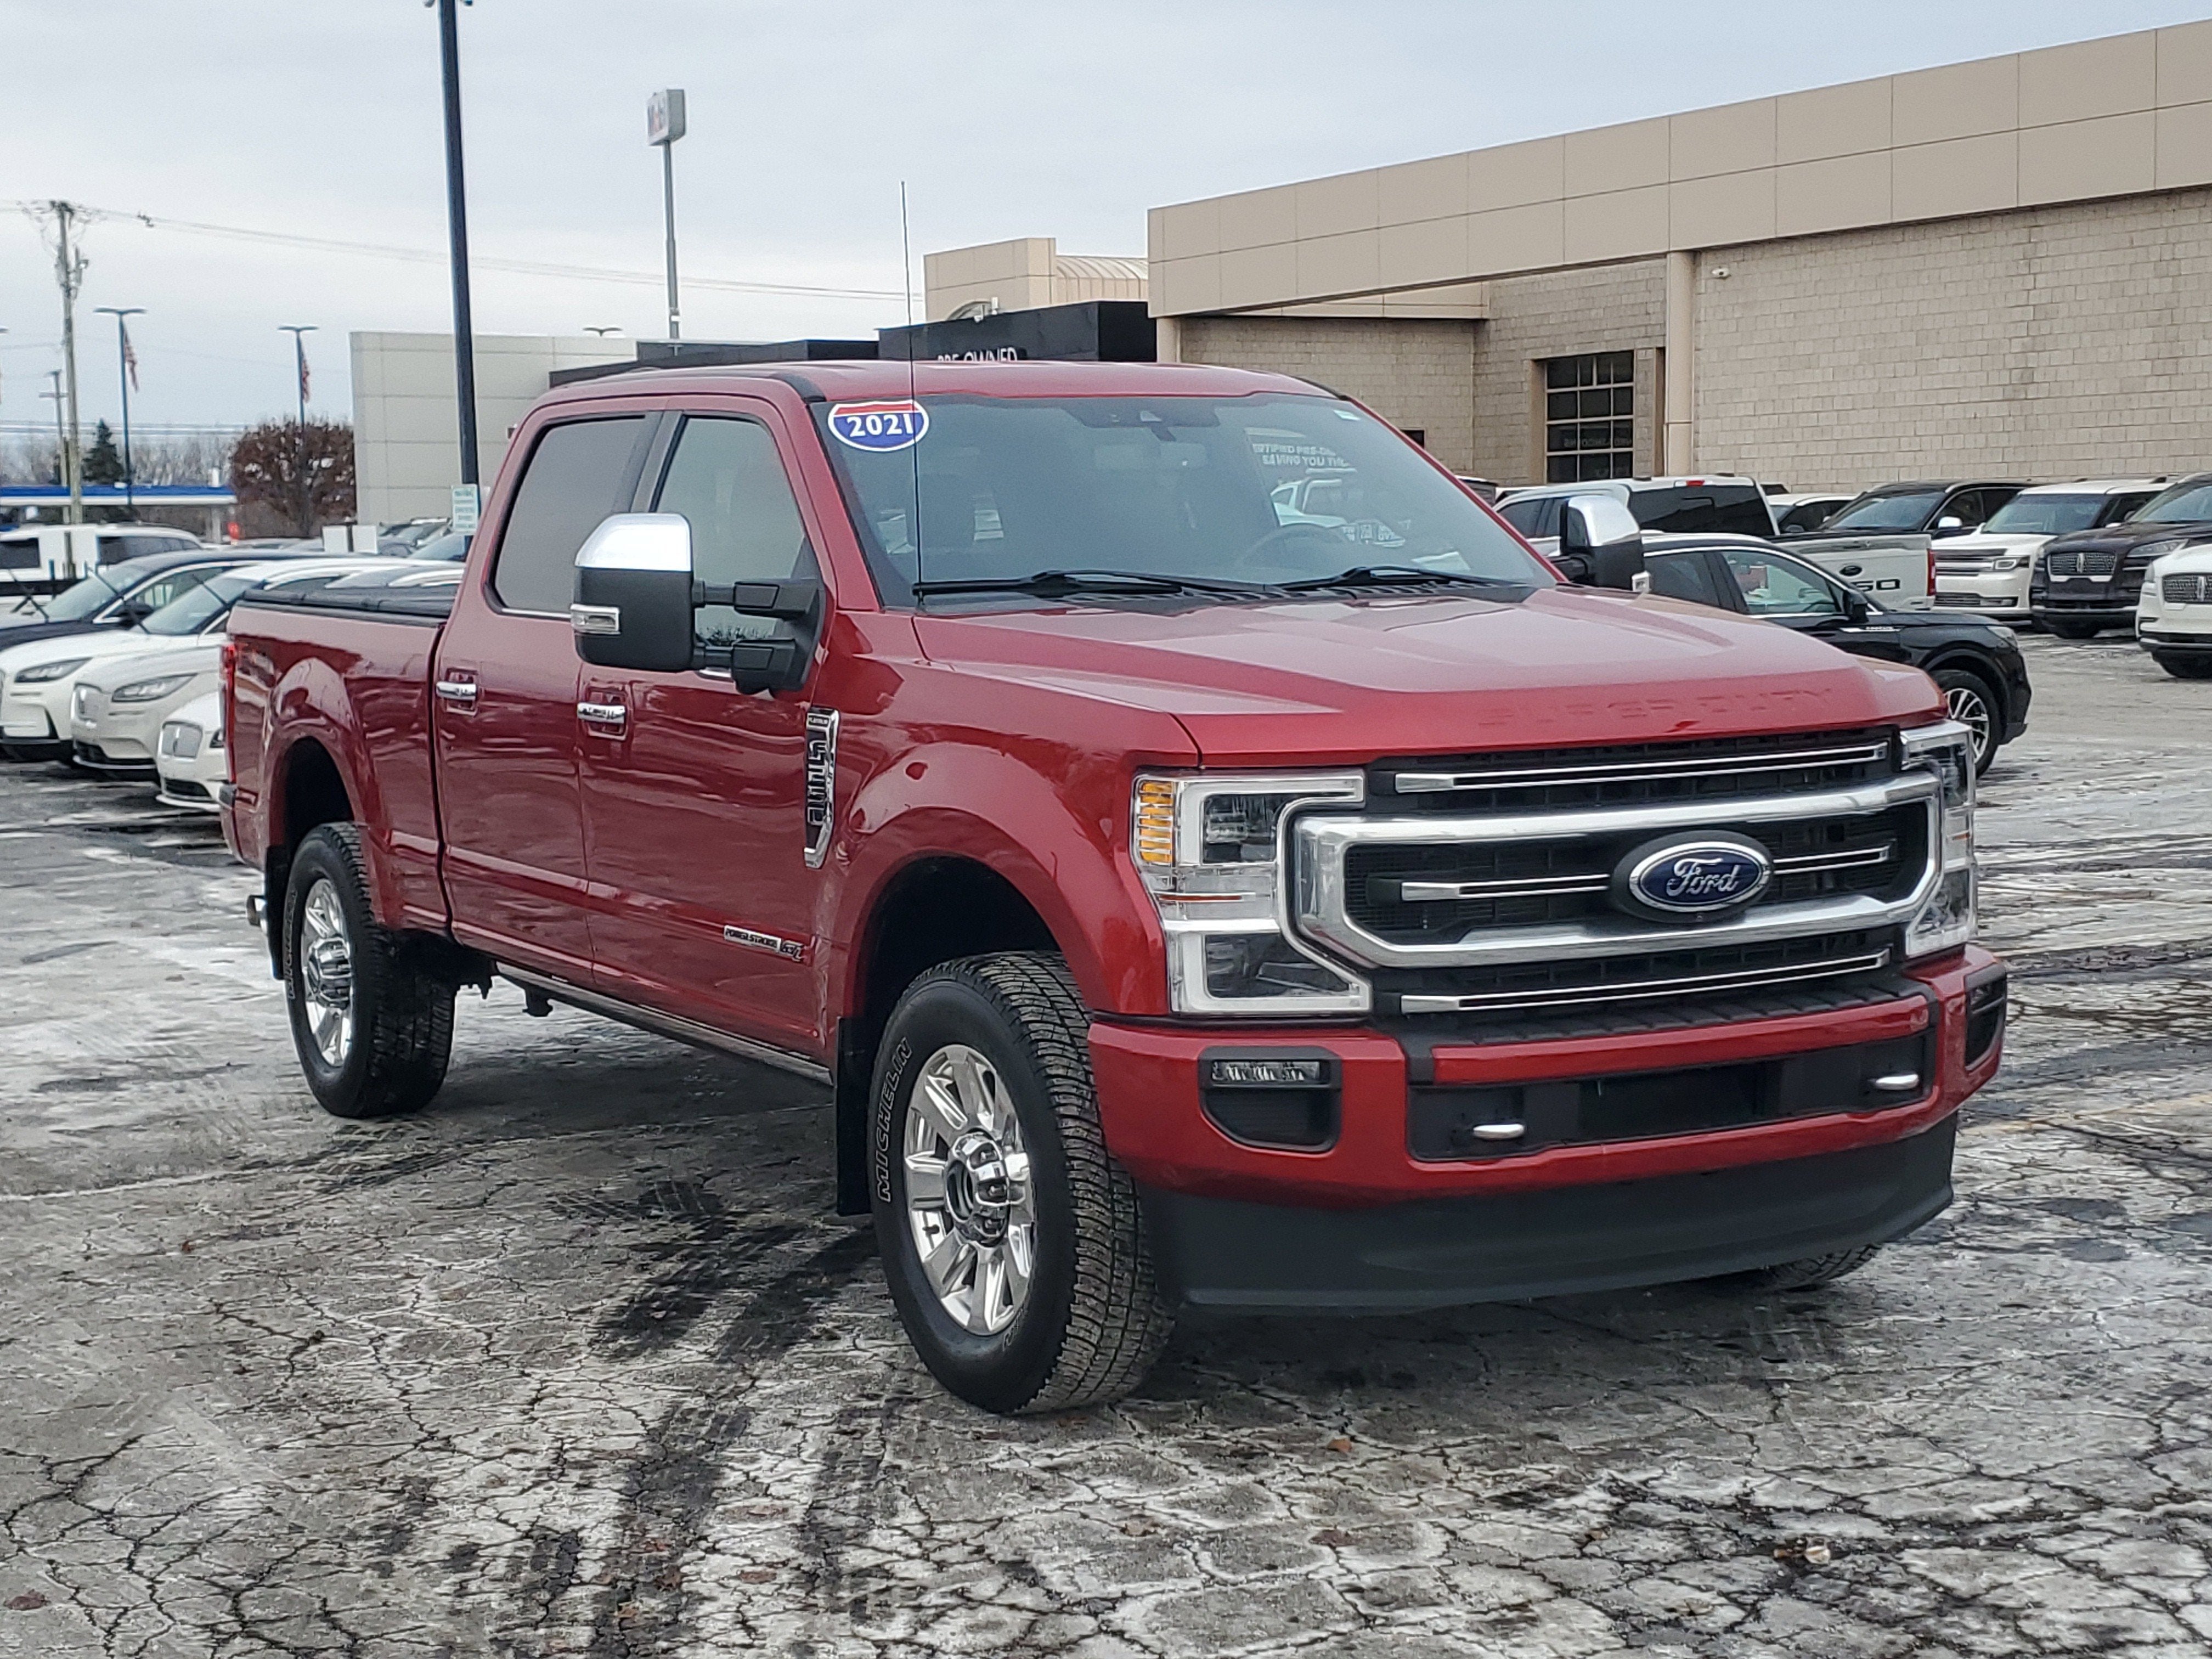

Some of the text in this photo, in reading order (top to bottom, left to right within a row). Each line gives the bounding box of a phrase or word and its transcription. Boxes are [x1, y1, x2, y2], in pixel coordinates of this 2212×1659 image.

[847, 414, 913, 437] 2021
[1302, 456, 1324, 466] YOU
[1666, 859, 1740, 896] Ford
[876, 1037, 912, 1202] MICHELIN
